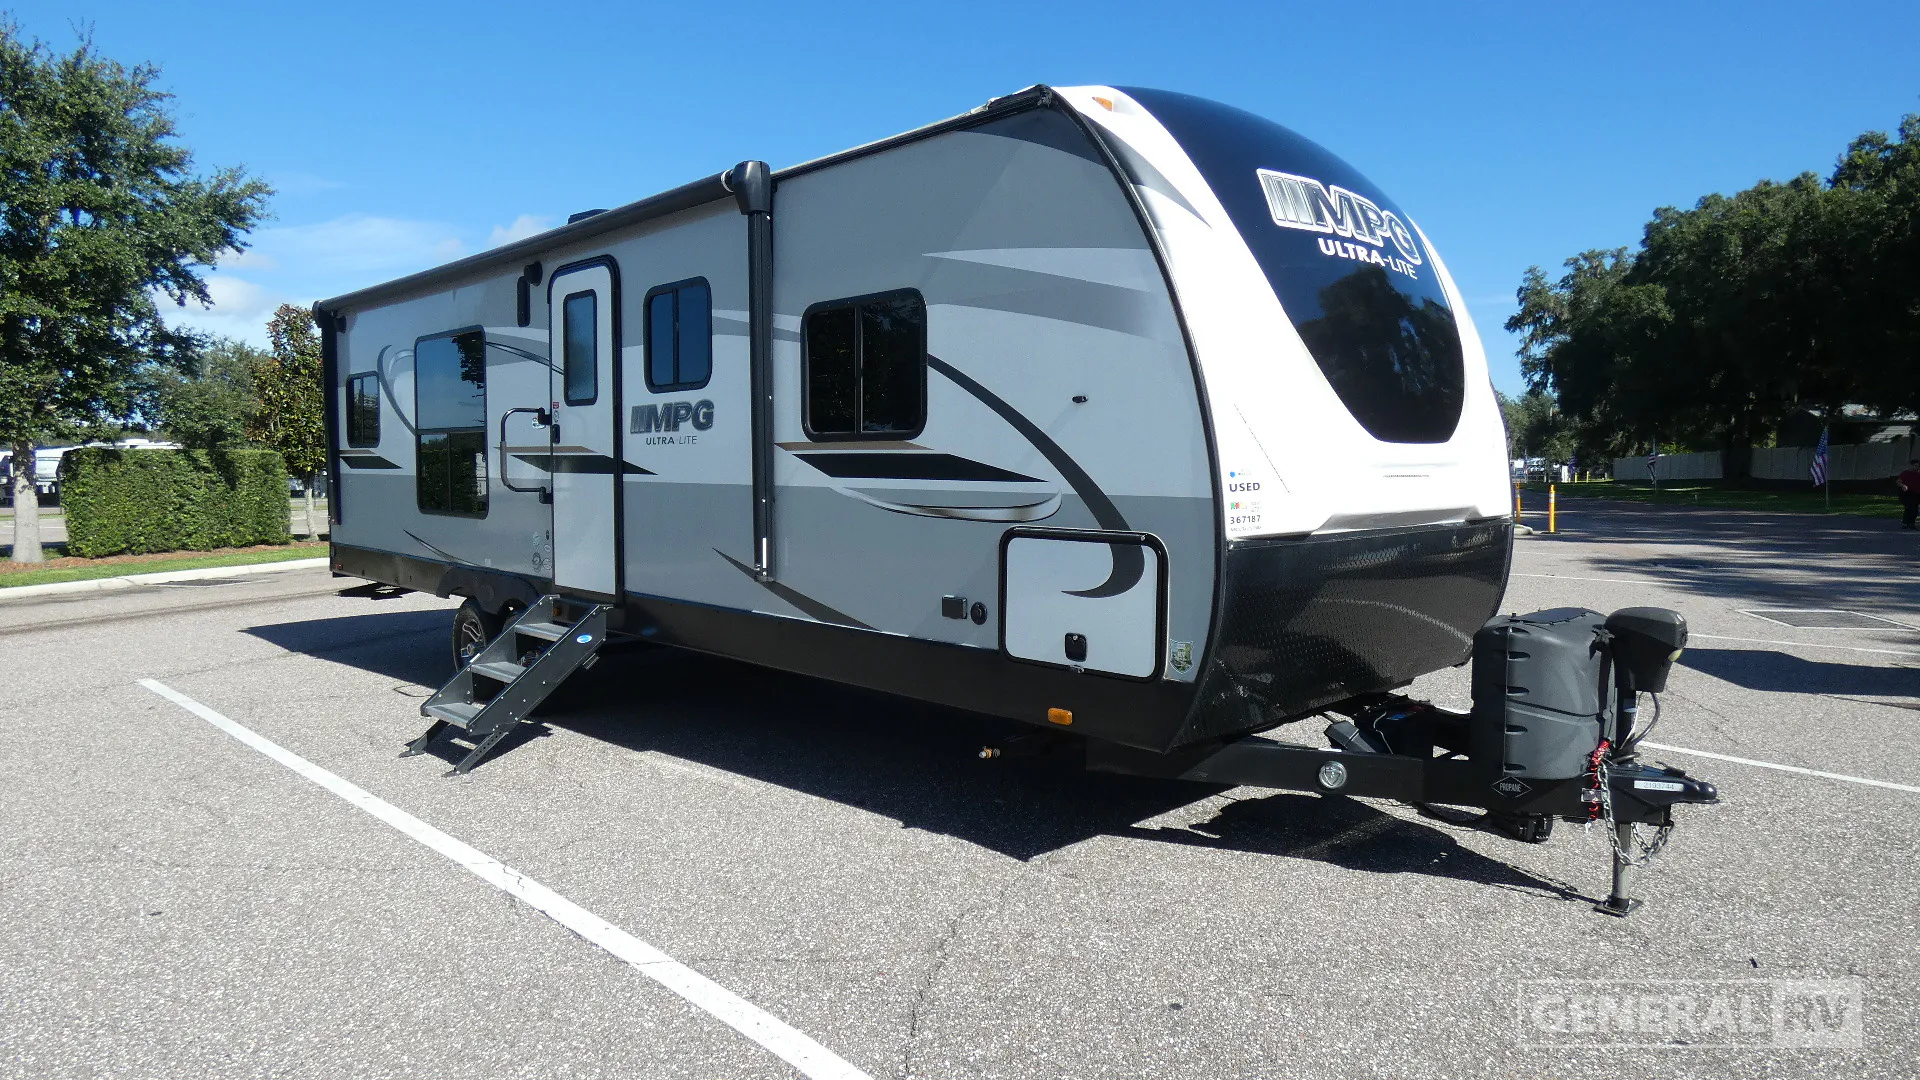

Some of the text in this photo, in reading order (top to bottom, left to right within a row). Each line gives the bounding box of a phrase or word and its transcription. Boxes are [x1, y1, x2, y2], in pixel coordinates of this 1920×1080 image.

[1257, 168, 1423, 265] MPG
[1317, 237, 1418, 280] ULTRA-LITE
[630, 398, 715, 434] MPG
[1229, 482, 1261, 492] USED
[1230, 515, 1261, 525] 367187
[1499, 782, 1522, 792] PROPANE
